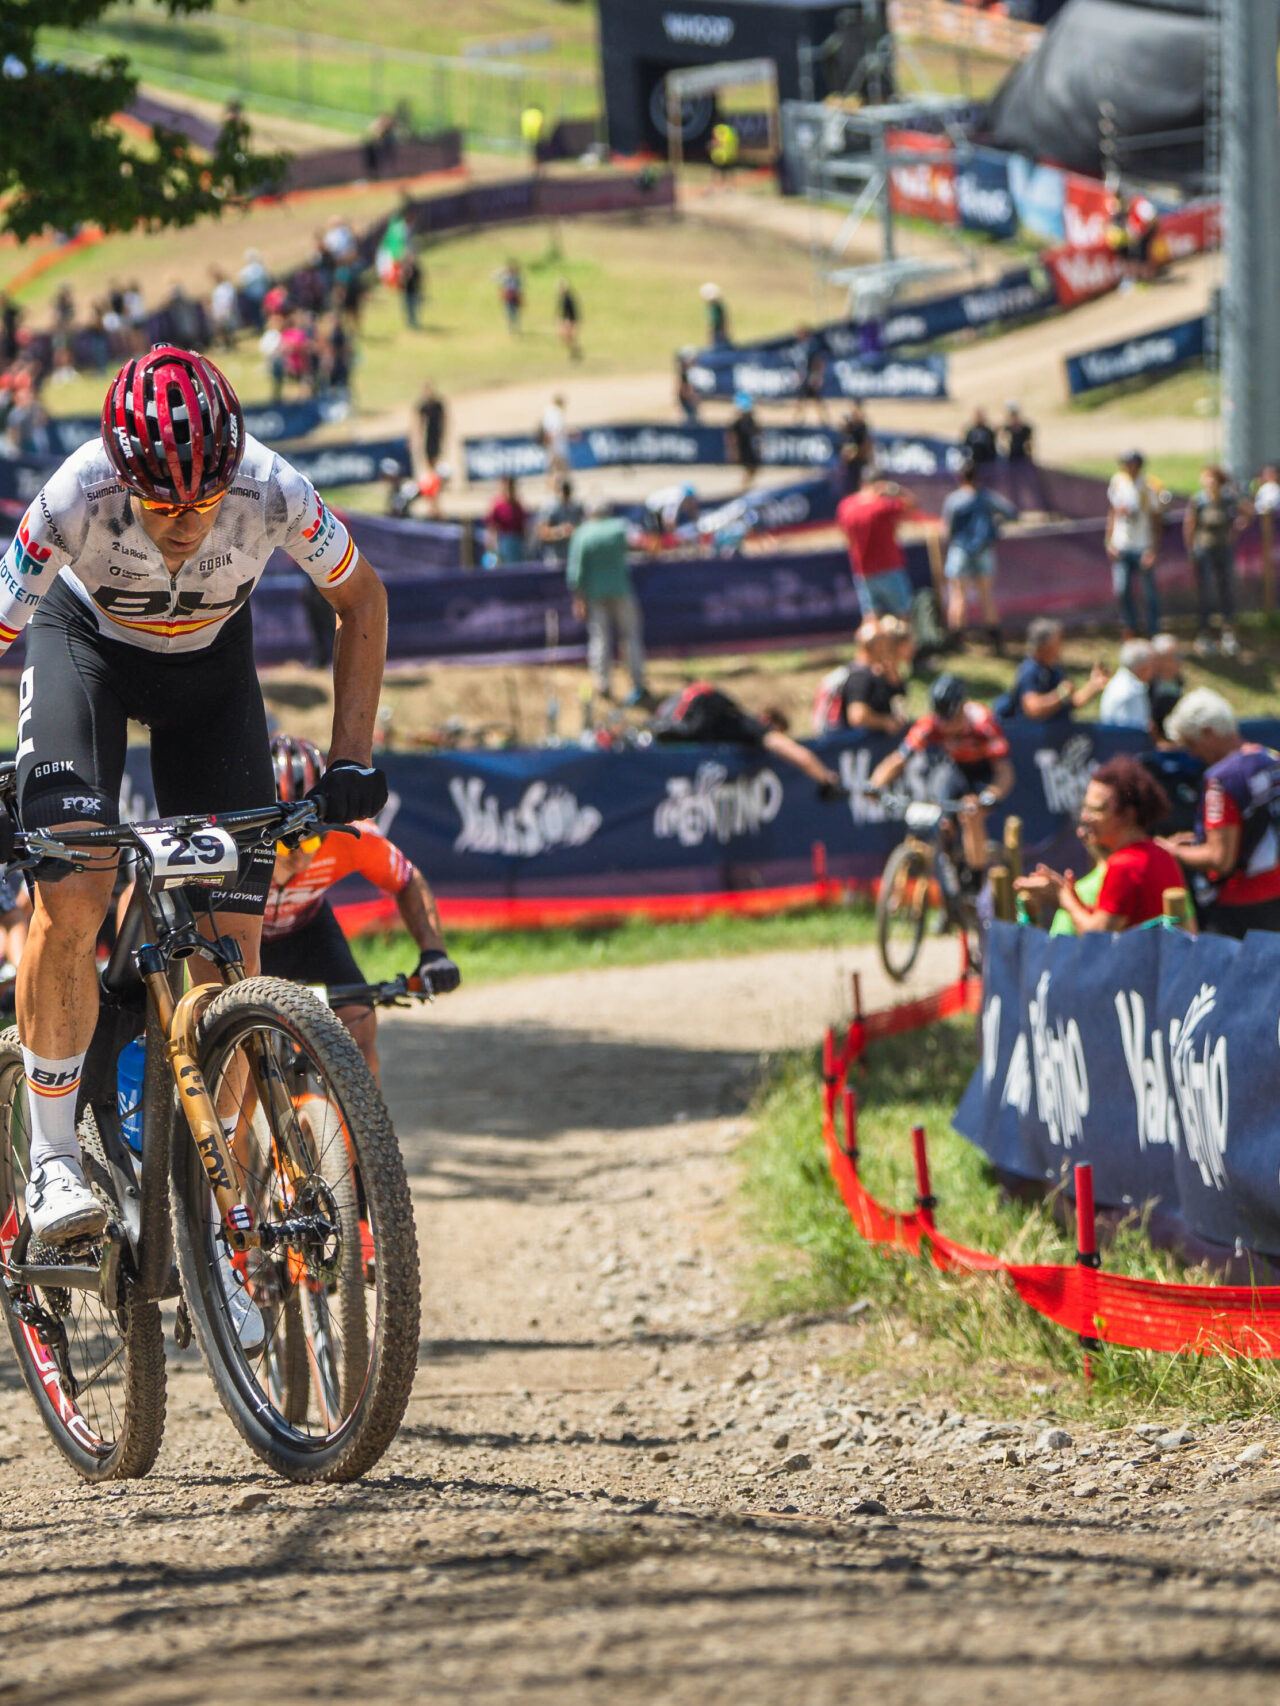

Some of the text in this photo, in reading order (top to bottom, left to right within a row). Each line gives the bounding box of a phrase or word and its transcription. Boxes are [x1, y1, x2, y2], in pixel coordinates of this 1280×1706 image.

[116, 426, 134, 459] LAZER
[199, 553, 233, 572] GOBIK
[91, 577, 256, 618] BH
[34, 760, 75, 779] GOBIK
[62, 796, 102, 815] FOX
[160, 834, 226, 866] 29
[30, 1064, 81, 1087] BH
[199, 1134, 231, 1190] FOX
